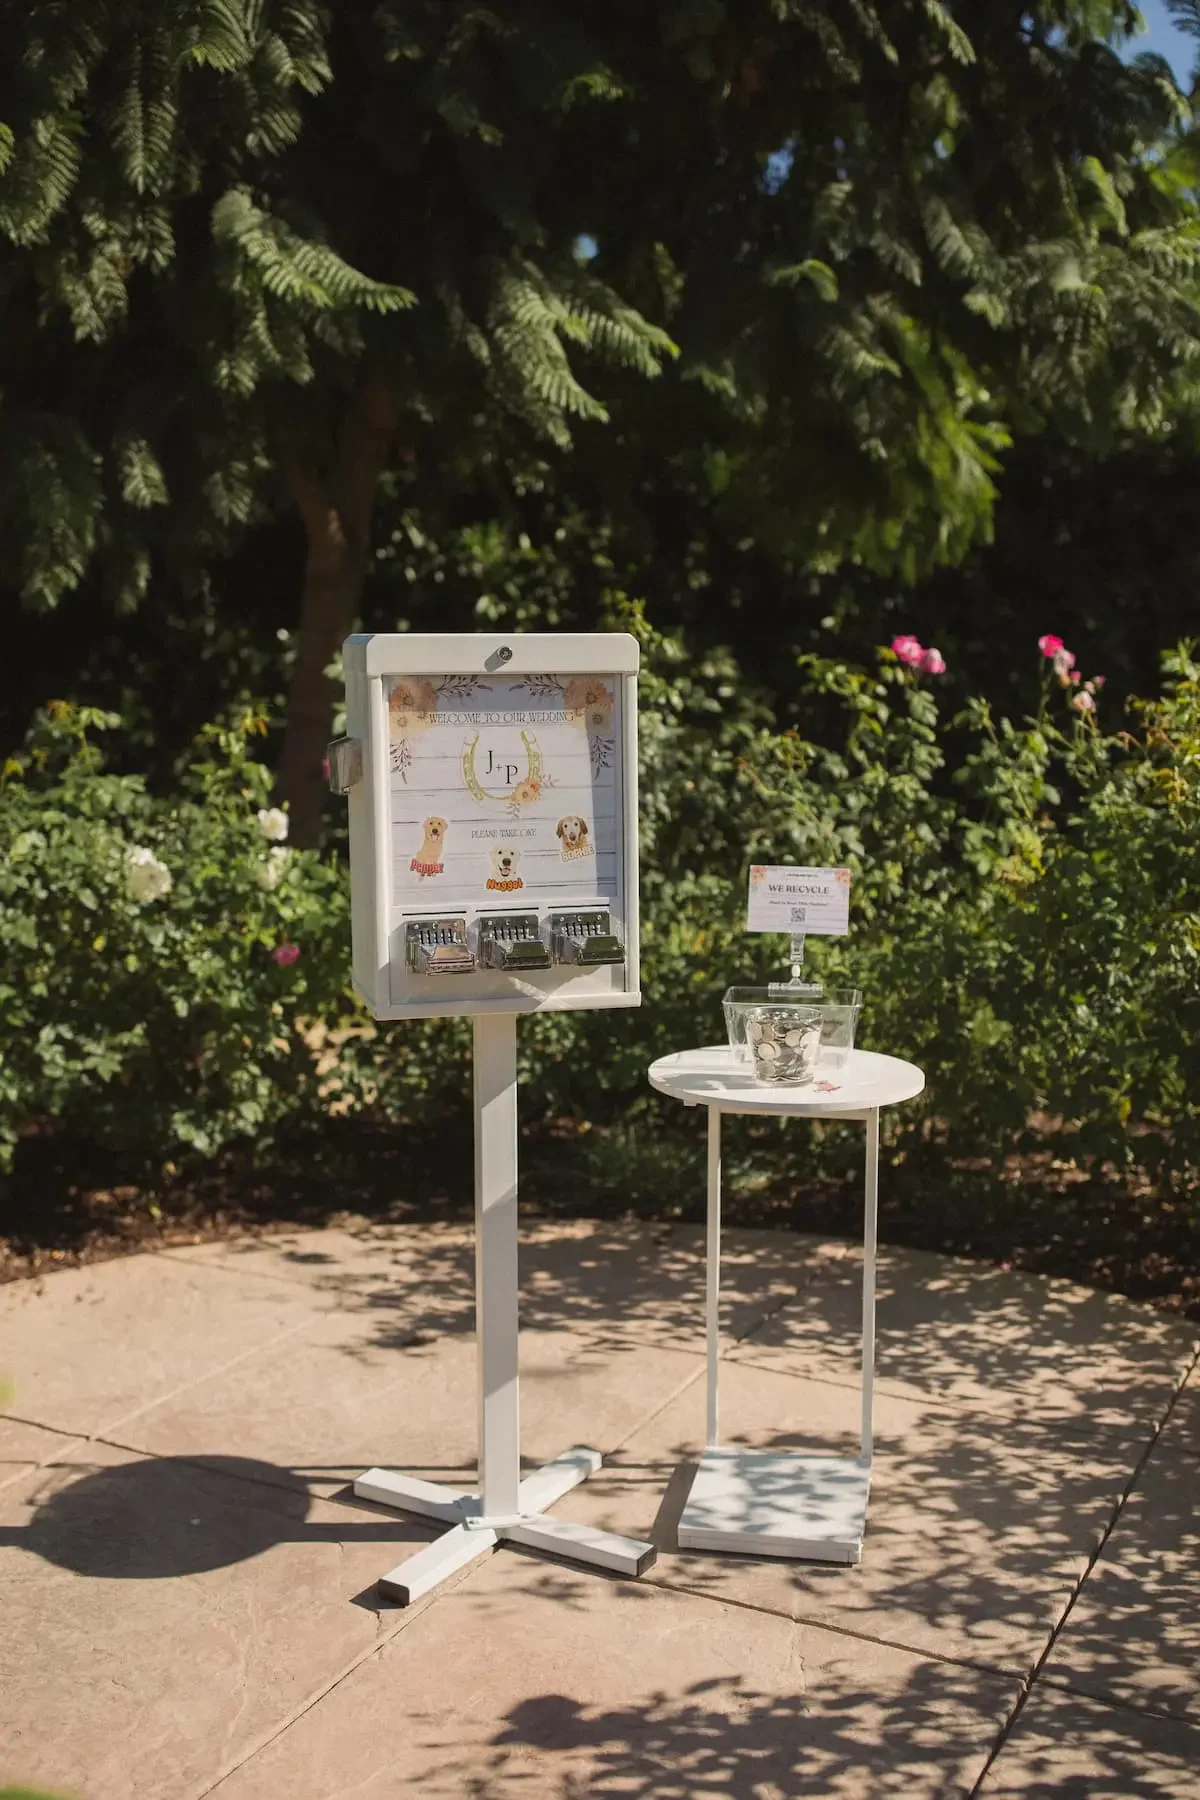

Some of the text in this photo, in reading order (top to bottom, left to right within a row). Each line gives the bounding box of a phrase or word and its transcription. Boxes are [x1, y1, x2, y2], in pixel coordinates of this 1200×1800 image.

[430, 711, 574, 724] WELCOME TO OUR WEDDING
[485, 750, 493, 774] J
[505, 765, 518, 784] P
[500, 829, 518, 838] TAKE
[486, 878, 523, 892] Nugget
[769, 884, 784, 893] WE
[786, 885, 830, 895] RECYCLE
